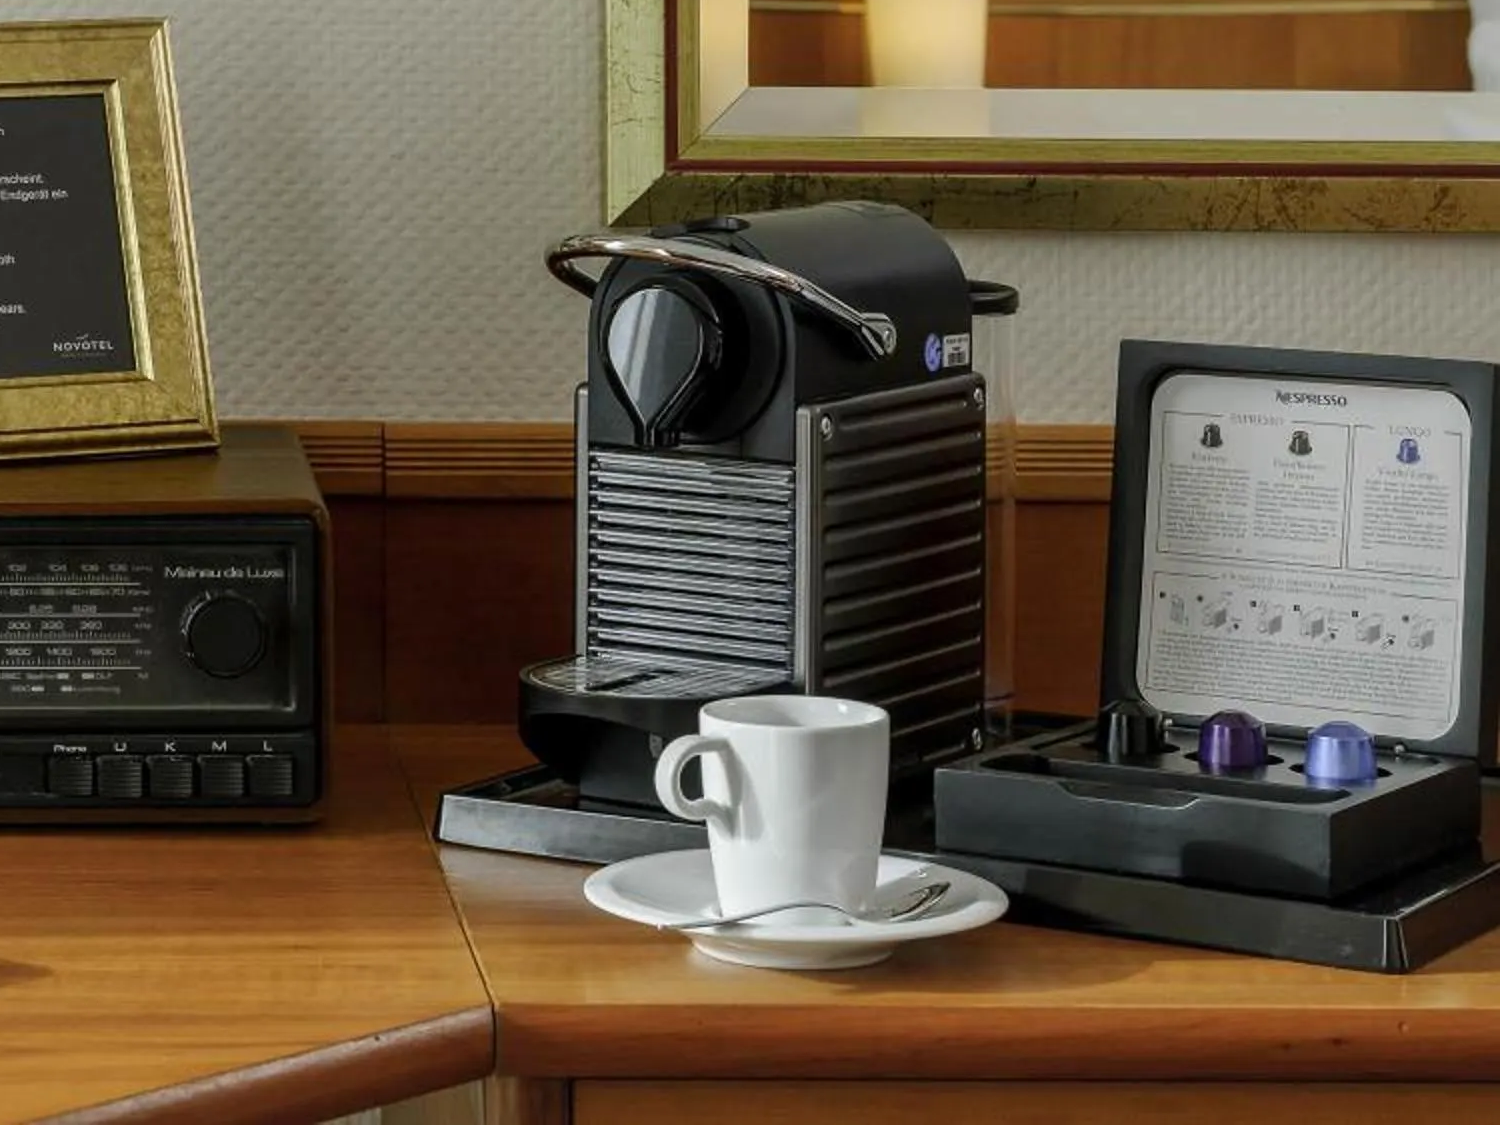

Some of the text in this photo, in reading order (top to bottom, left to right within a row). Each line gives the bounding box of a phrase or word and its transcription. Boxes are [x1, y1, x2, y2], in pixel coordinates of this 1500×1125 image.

[53, 340, 115, 352] NOVOTEL
[1275, 390, 1348, 408] NESPRESSO
[113, 742, 128, 752] U
[164, 741, 177, 752] K
[211, 740, 228, 752] M
[262, 740, 273, 752] L
